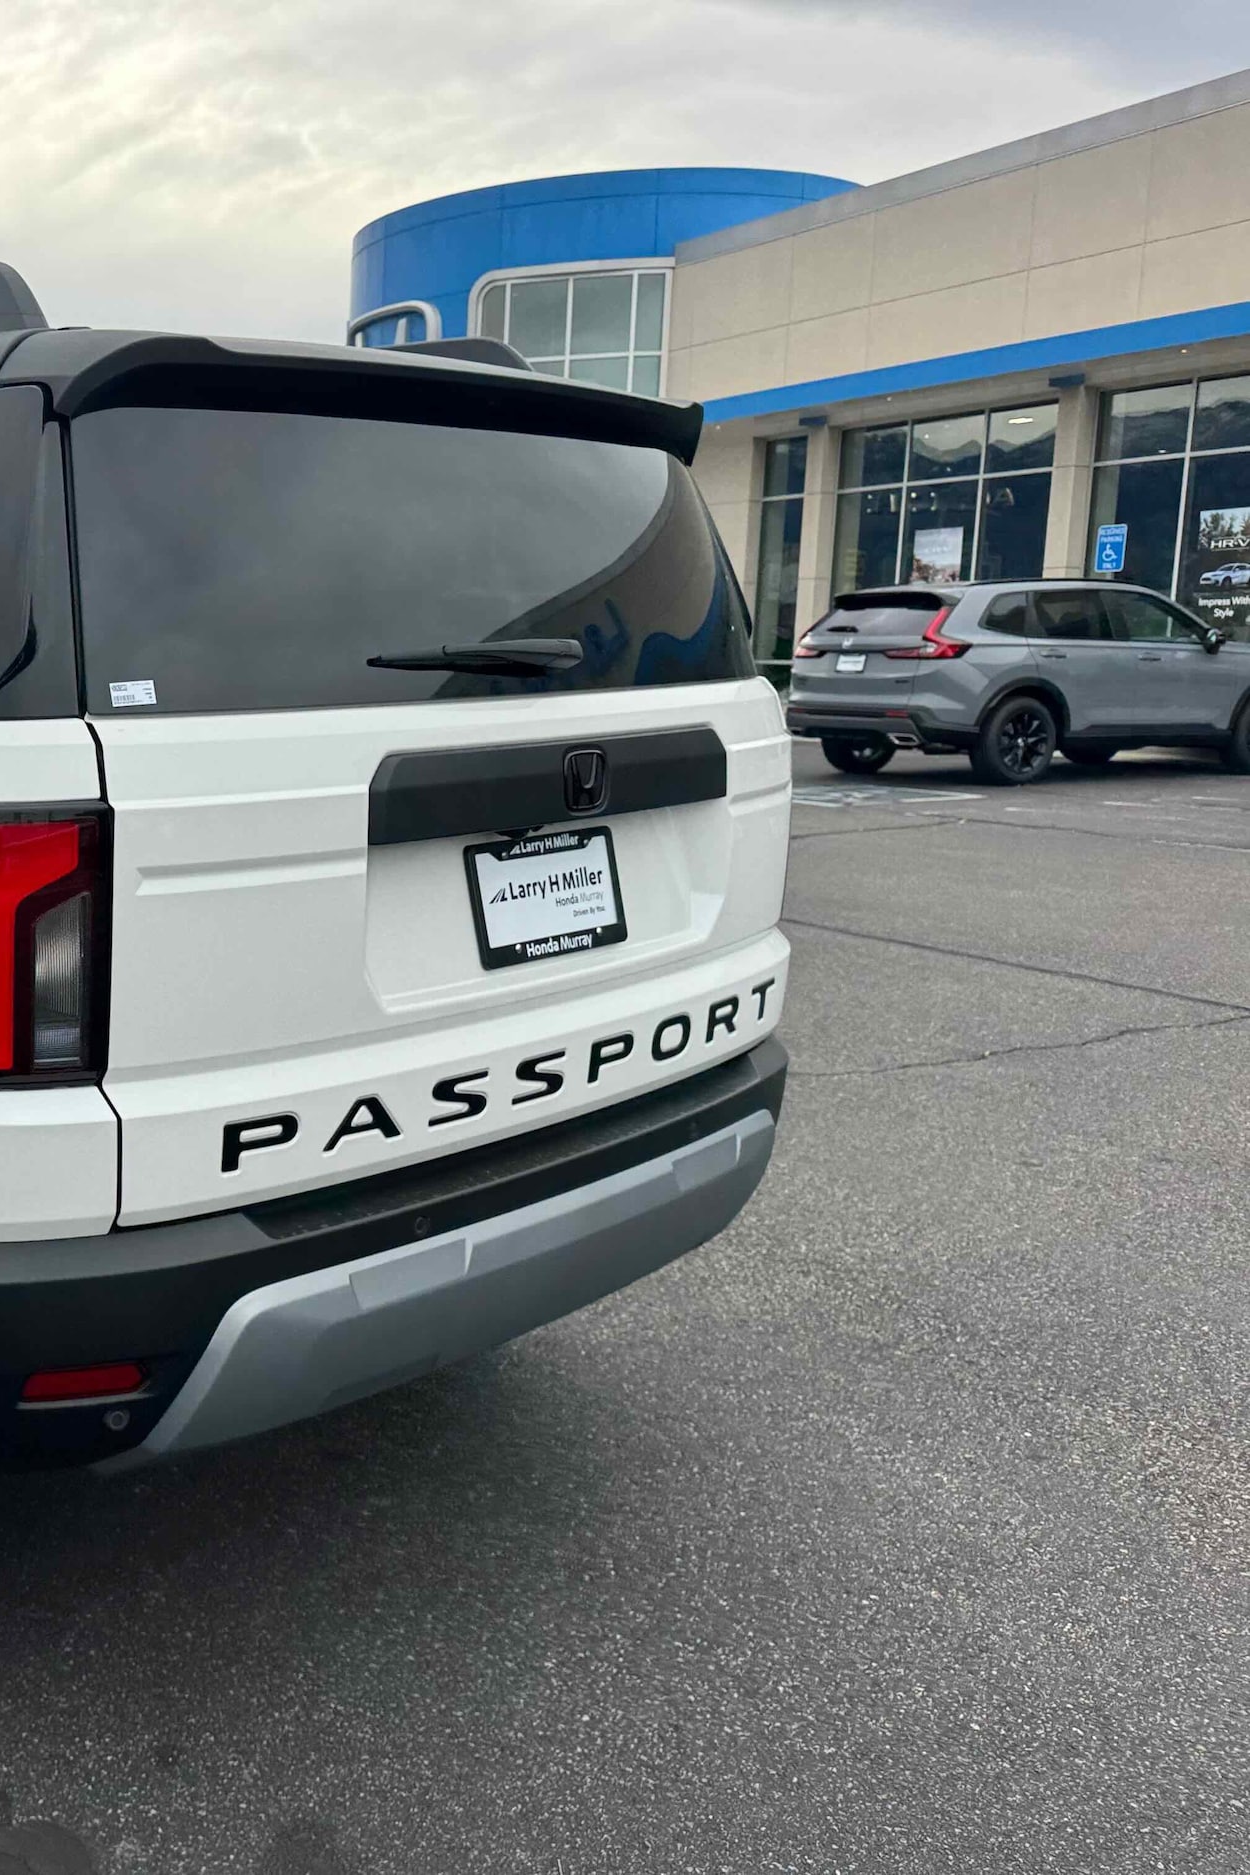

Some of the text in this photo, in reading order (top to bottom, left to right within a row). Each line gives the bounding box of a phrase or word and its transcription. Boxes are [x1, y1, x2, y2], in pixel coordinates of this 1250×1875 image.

[1198, 597, 1231, 608] Impress
[1213, 607, 1235, 619] Style
[520, 833, 579, 854] Larry H Miller
[508, 866, 603, 900] Larry H Miller
[555, 891, 604, 907] Honda Murray
[525, 933, 593, 958] Honda Murray
[220, 977, 776, 1174] PASSPORT
